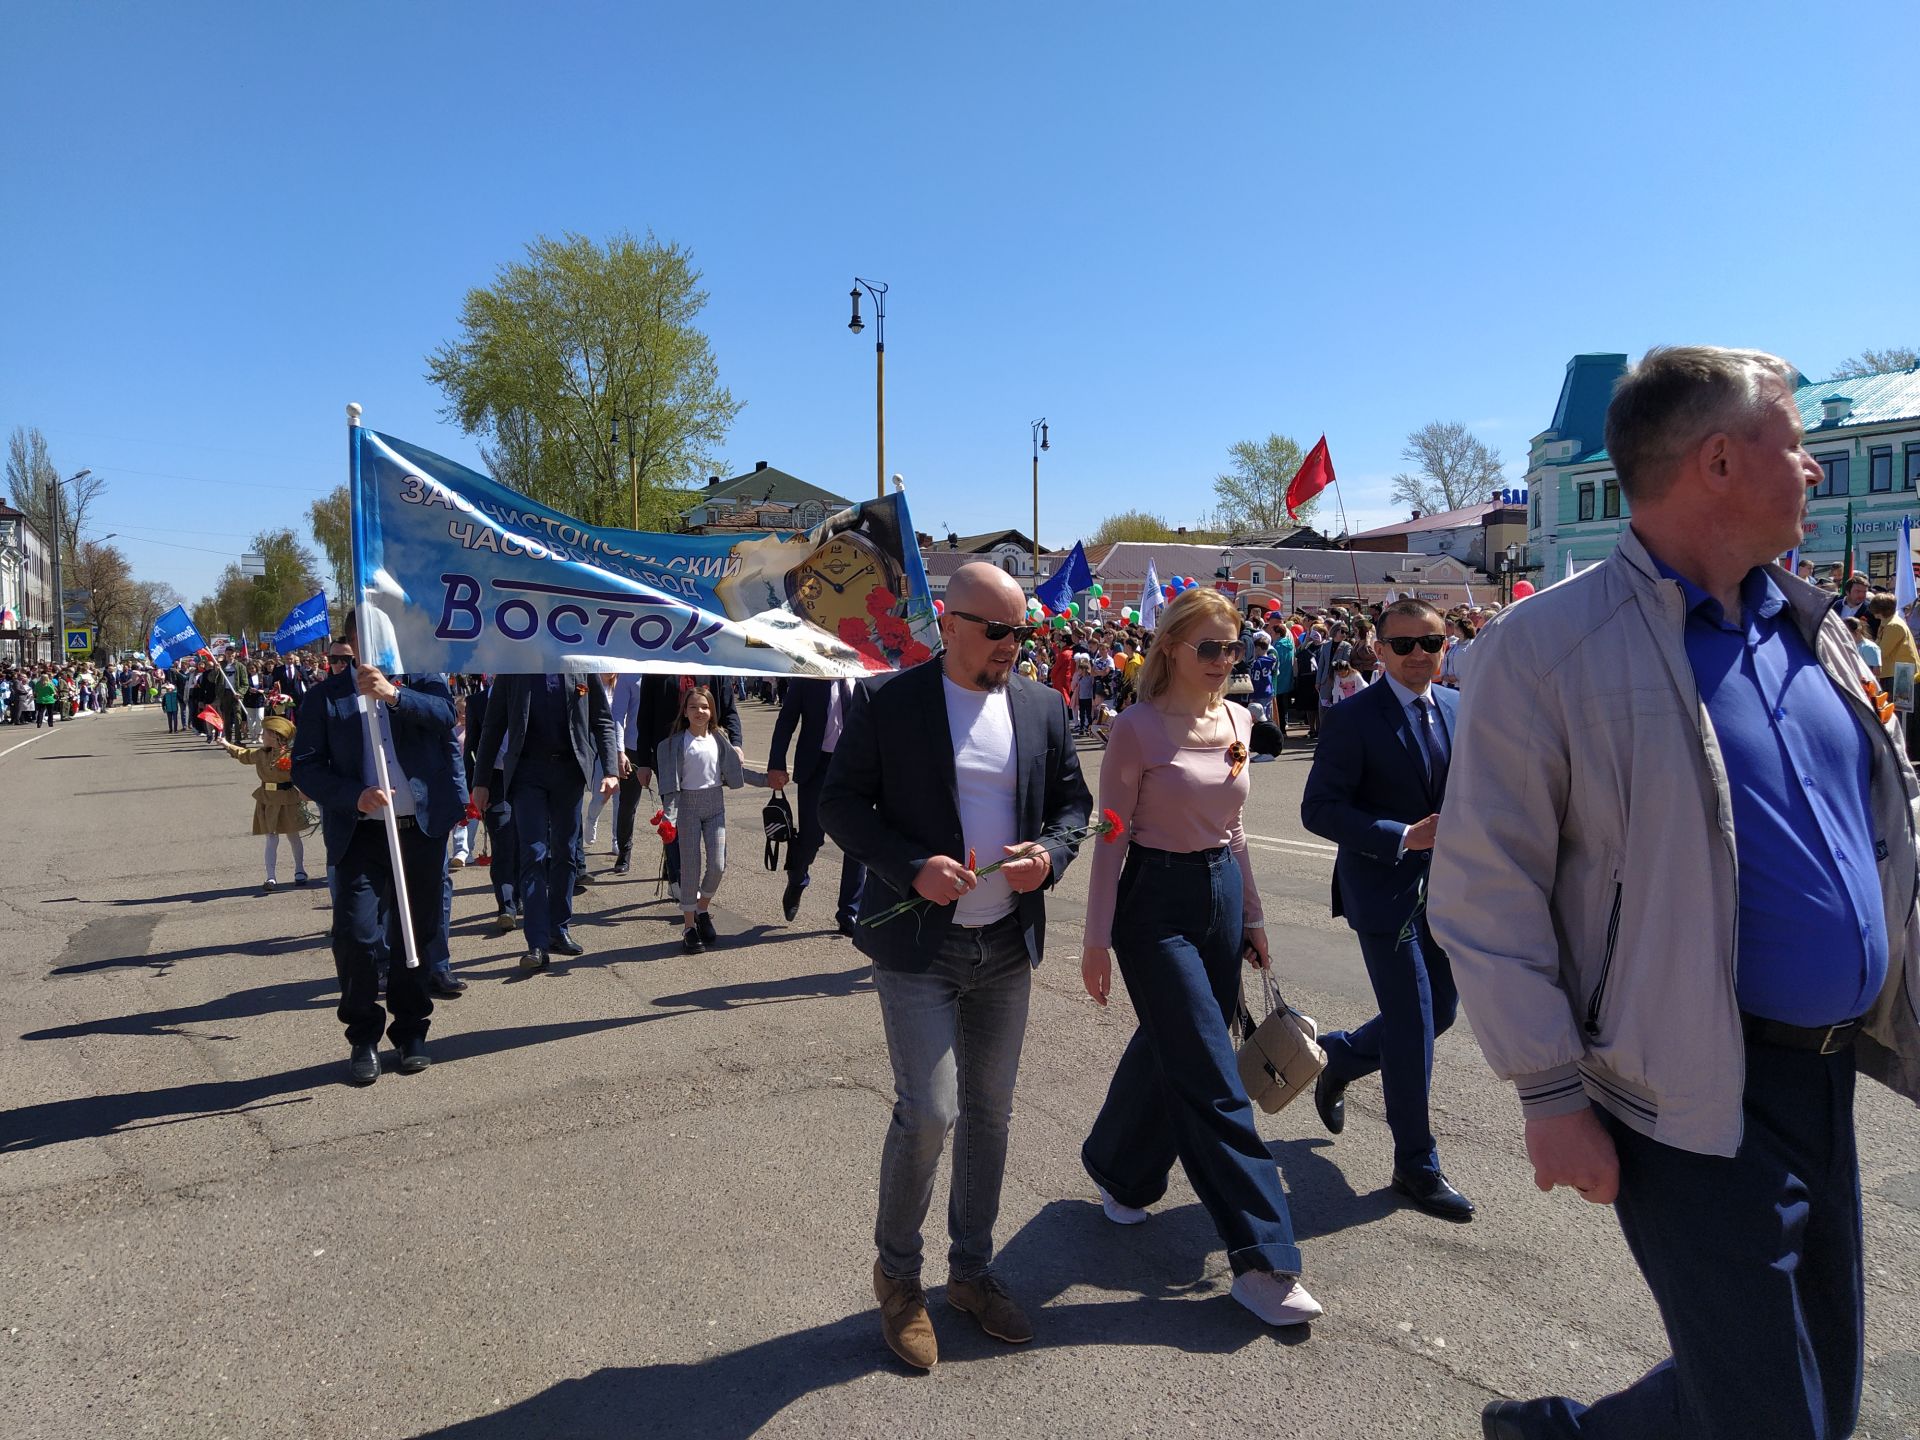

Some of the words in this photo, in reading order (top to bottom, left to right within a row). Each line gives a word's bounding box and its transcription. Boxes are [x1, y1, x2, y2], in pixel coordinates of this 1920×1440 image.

[400, 475, 476, 513] ЗАО
[478, 499, 743, 578] ЧИСТОПОСКИЙ
[1831, 522, 1879, 535] LONGE
